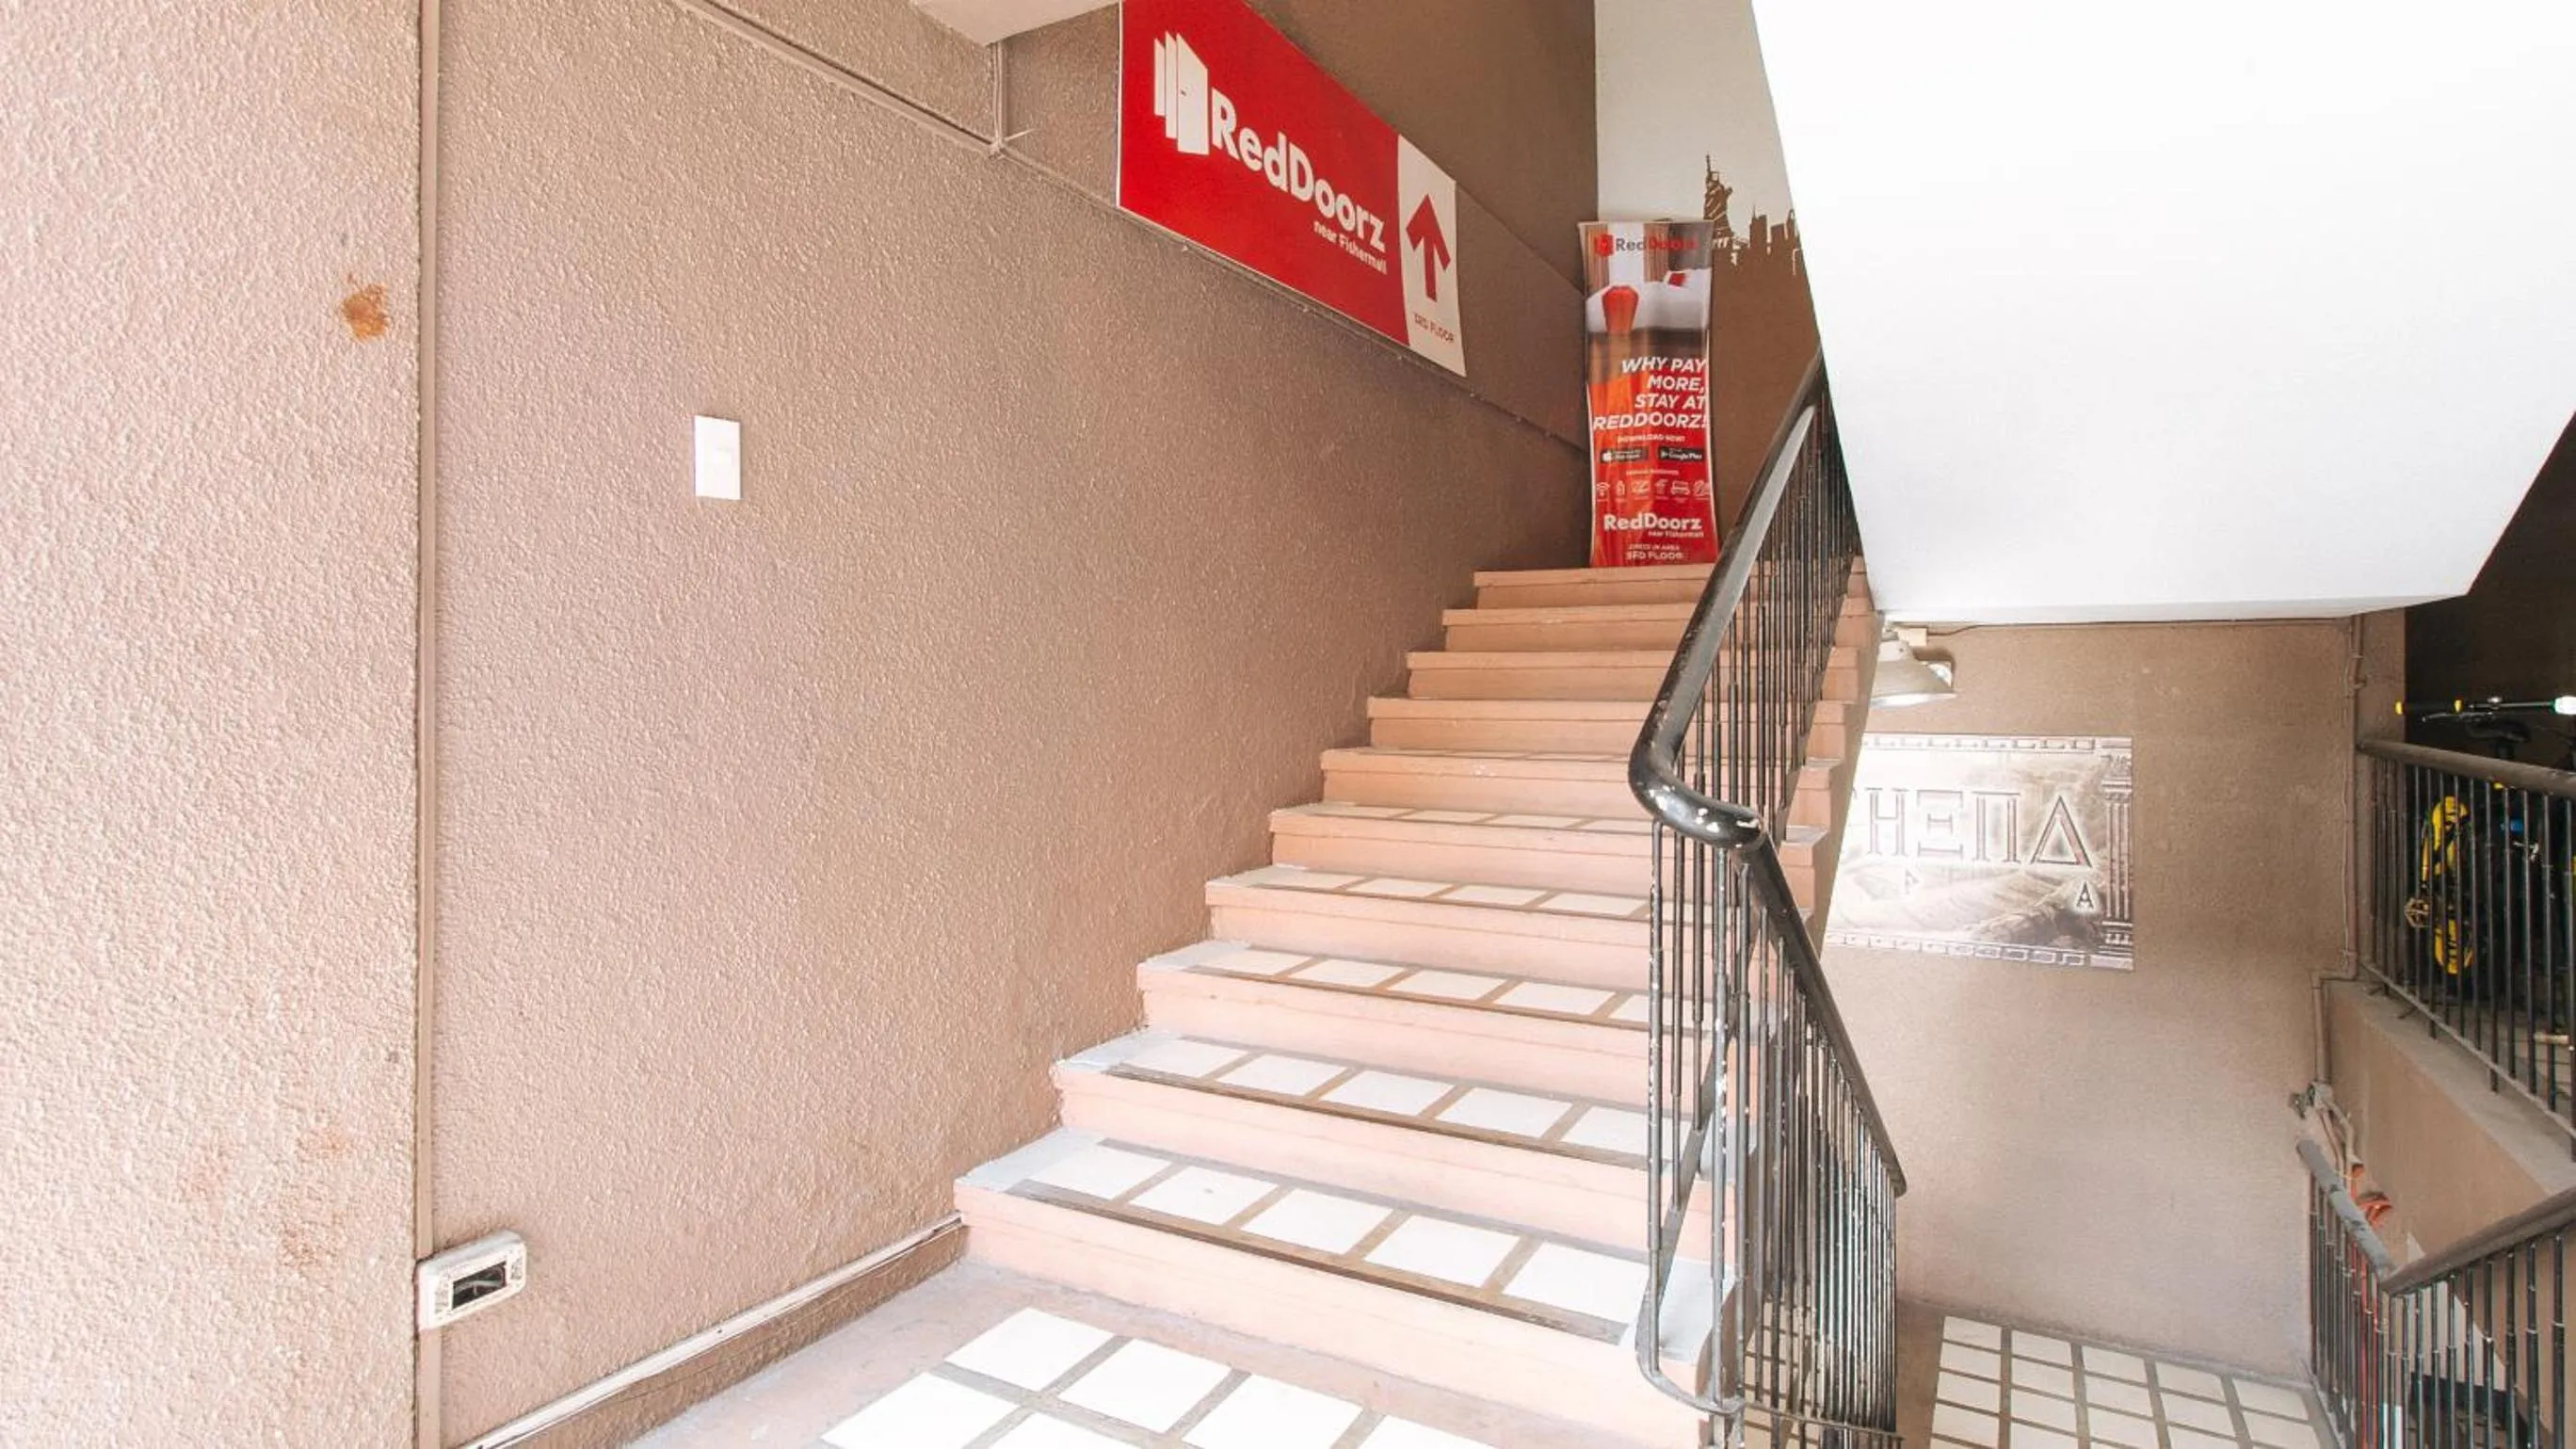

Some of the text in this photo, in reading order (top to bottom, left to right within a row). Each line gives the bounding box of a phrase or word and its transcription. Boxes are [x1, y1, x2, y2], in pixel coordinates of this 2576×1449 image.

[1212, 86, 1386, 253] RedDoorz
[1312, 219, 1338, 245] near
[1621, 356, 1708, 373] WHY PAY
[1647, 375, 1705, 394] MORE,
[1634, 392, 1708, 410] STAY AT
[1592, 411, 1708, 430] REDDOORZ!
[1603, 512, 1702, 531] RedDoorz
